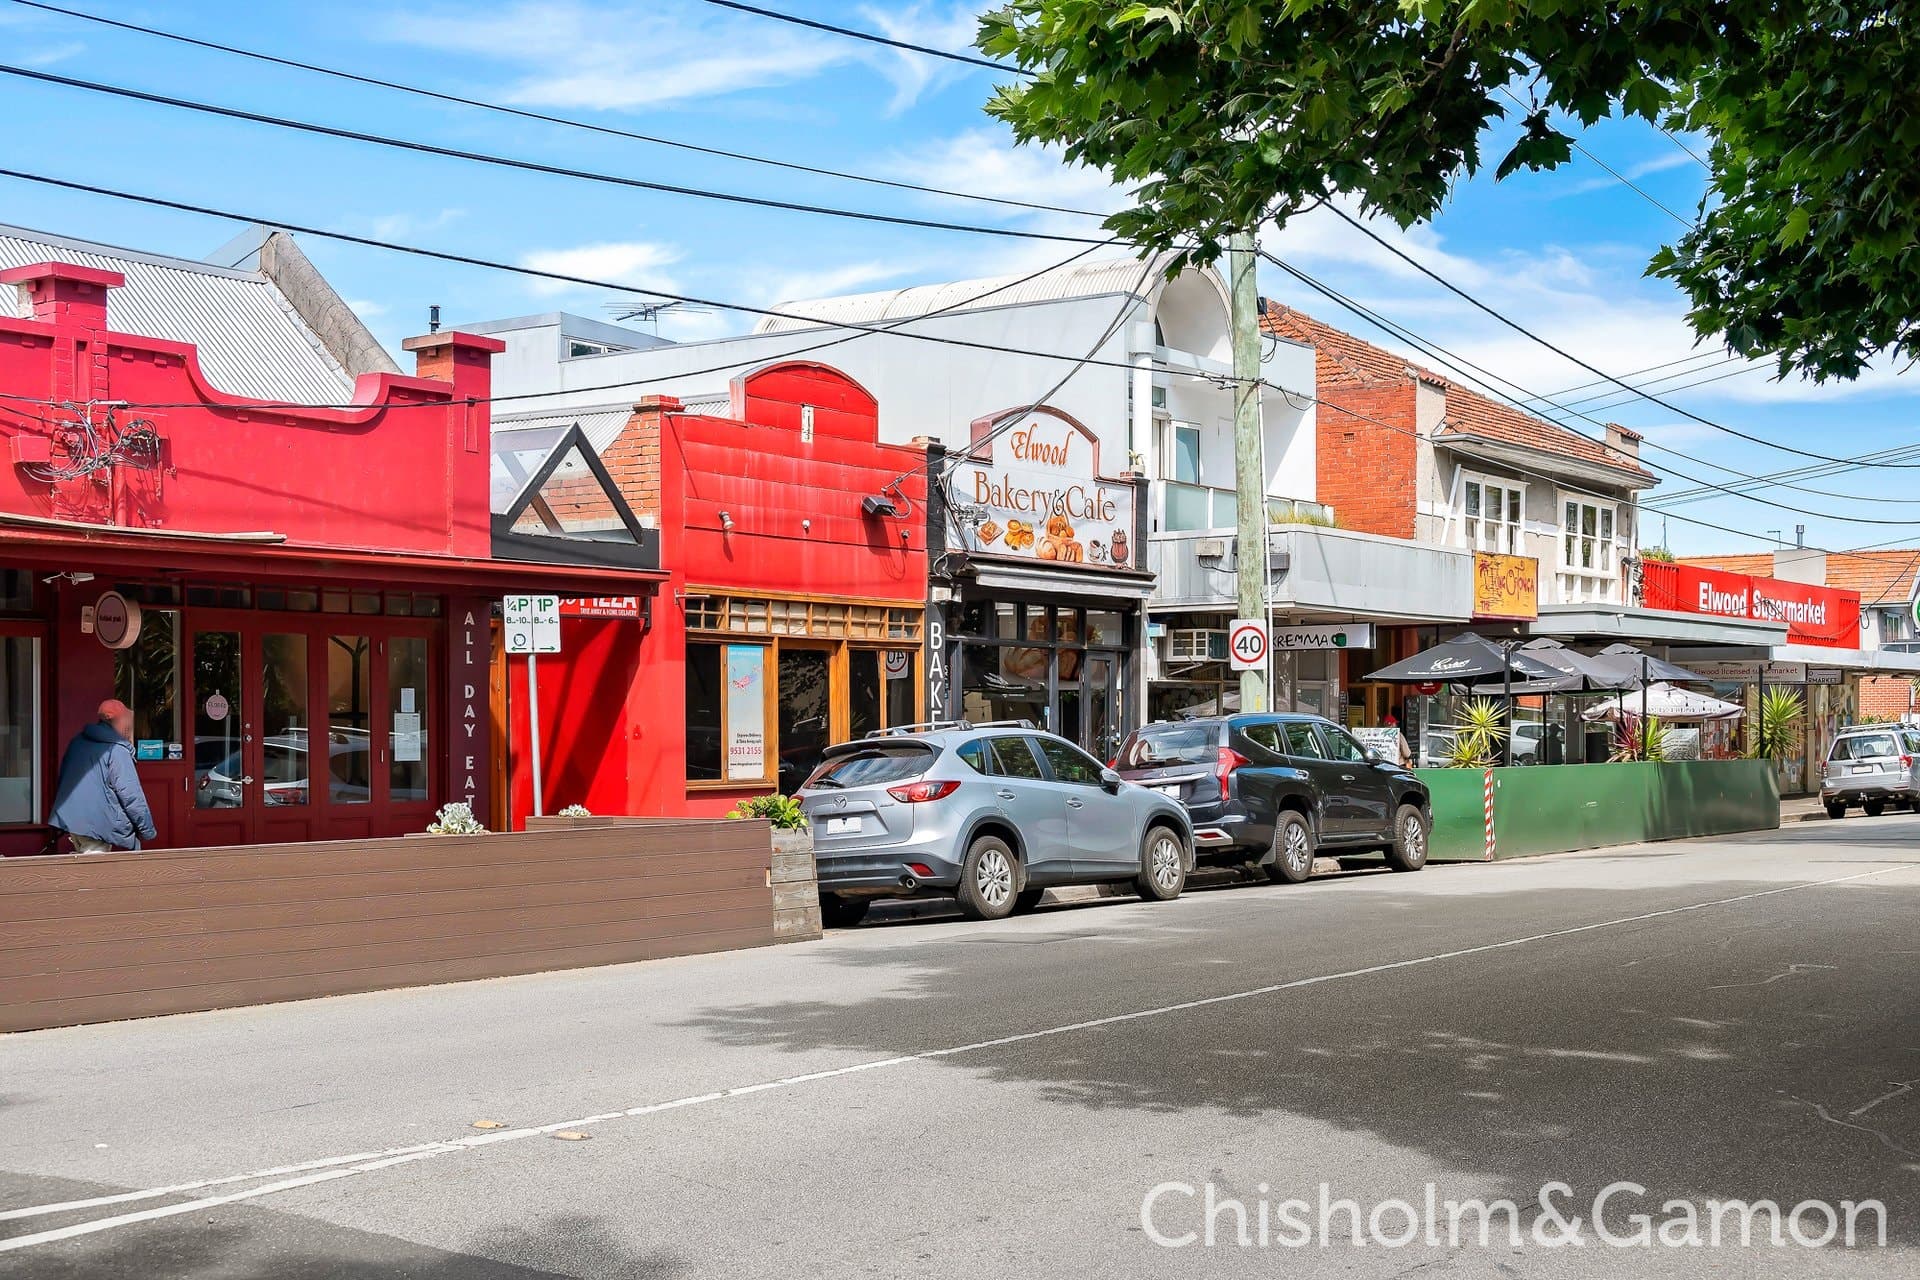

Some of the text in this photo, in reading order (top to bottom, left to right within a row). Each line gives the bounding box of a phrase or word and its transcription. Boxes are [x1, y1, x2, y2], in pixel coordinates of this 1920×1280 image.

[1010, 422, 1074, 467] Elwood
[973, 471, 1051, 527] Bakery
[1066, 485, 1116, 521] Cafe
[537, 598, 554, 612] 1P
[1699, 581, 1827, 626] Elwood Supermarket
[464, 611, 475, 664] ALL
[1236, 635, 1262, 653] 40
[1721, 667, 1751, 676] licensed
[464, 684, 475, 737] DAY
[730, 746, 761, 755] 9531 2155
